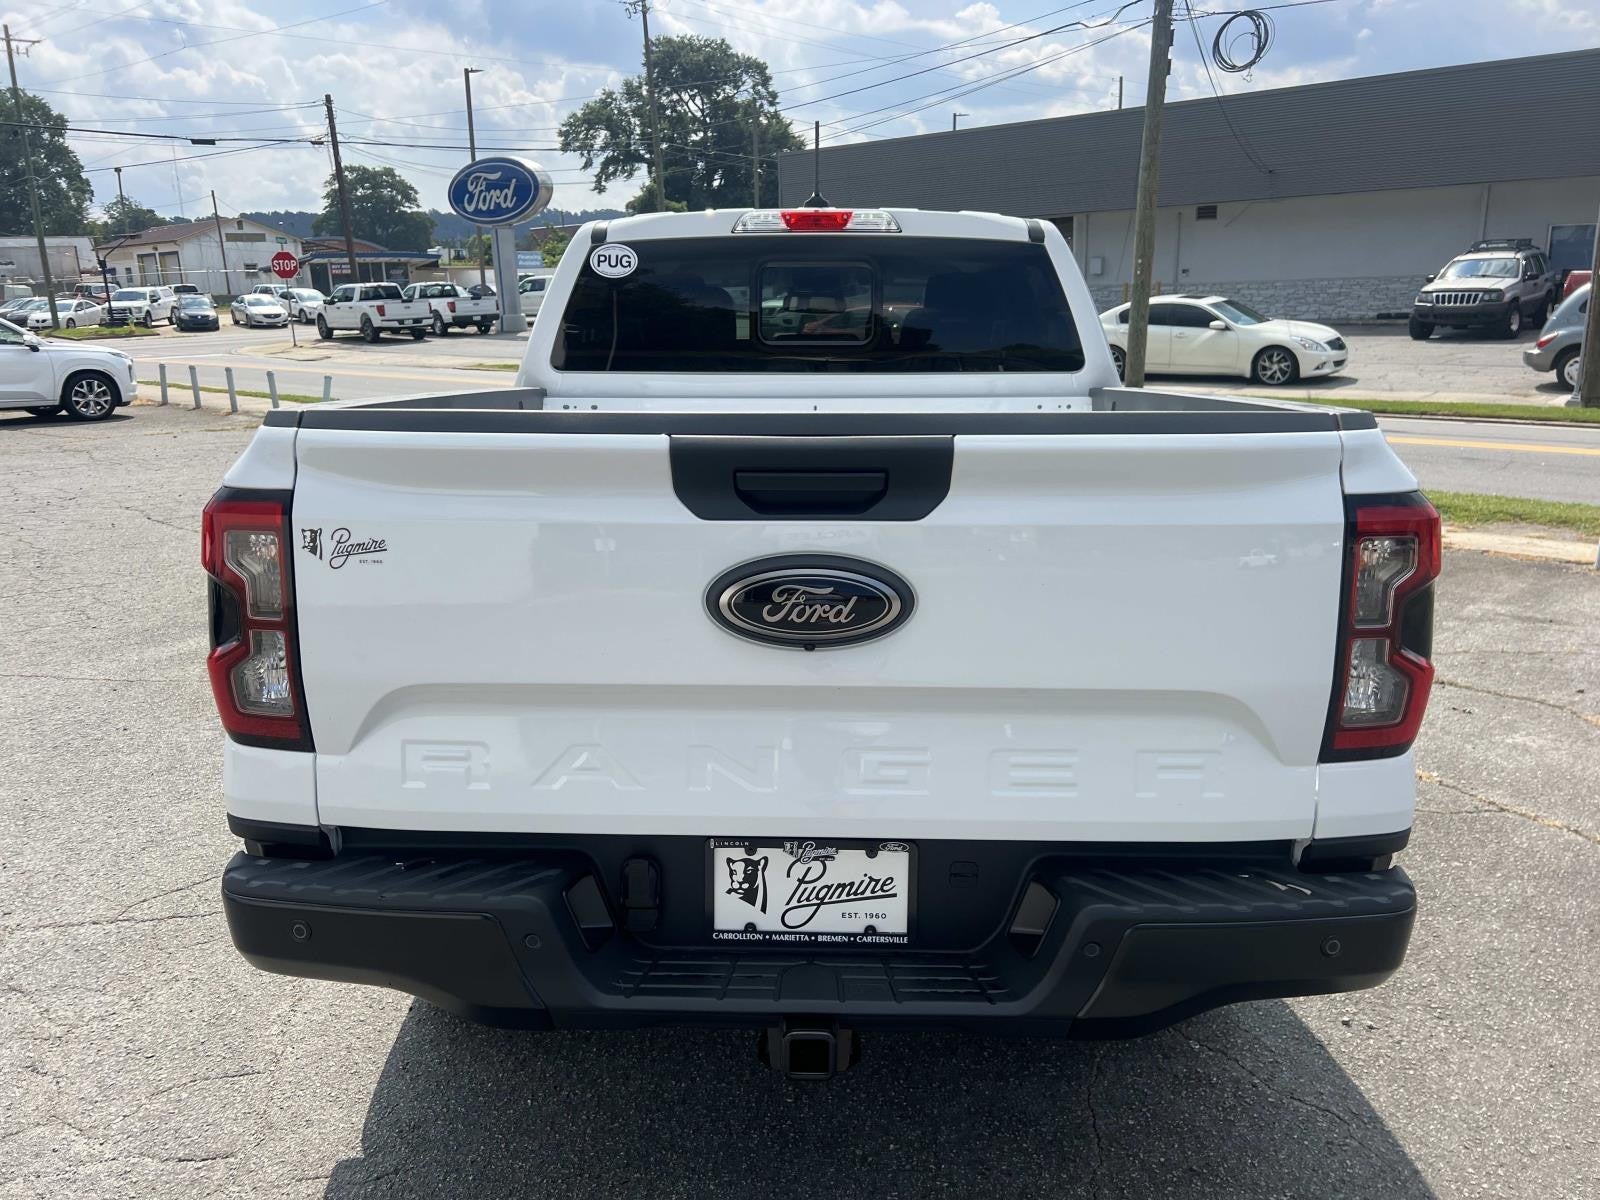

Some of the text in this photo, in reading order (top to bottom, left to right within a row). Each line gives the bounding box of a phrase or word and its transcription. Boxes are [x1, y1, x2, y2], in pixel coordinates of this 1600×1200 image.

[464, 171, 516, 212] Ford
[273, 261, 297, 271] STOP
[597, 254, 632, 268] PUG
[329, 527, 387, 569] Pugmire
[762, 584, 858, 623] Ford
[400, 739, 1225, 798] RANGER
[781, 858, 897, 929] Pugmire
[713, 932, 763, 940] CARROLLTON
[772, 934, 809, 942] MARIETTA
[856, 935, 909, 944] CARTERSVILLE
